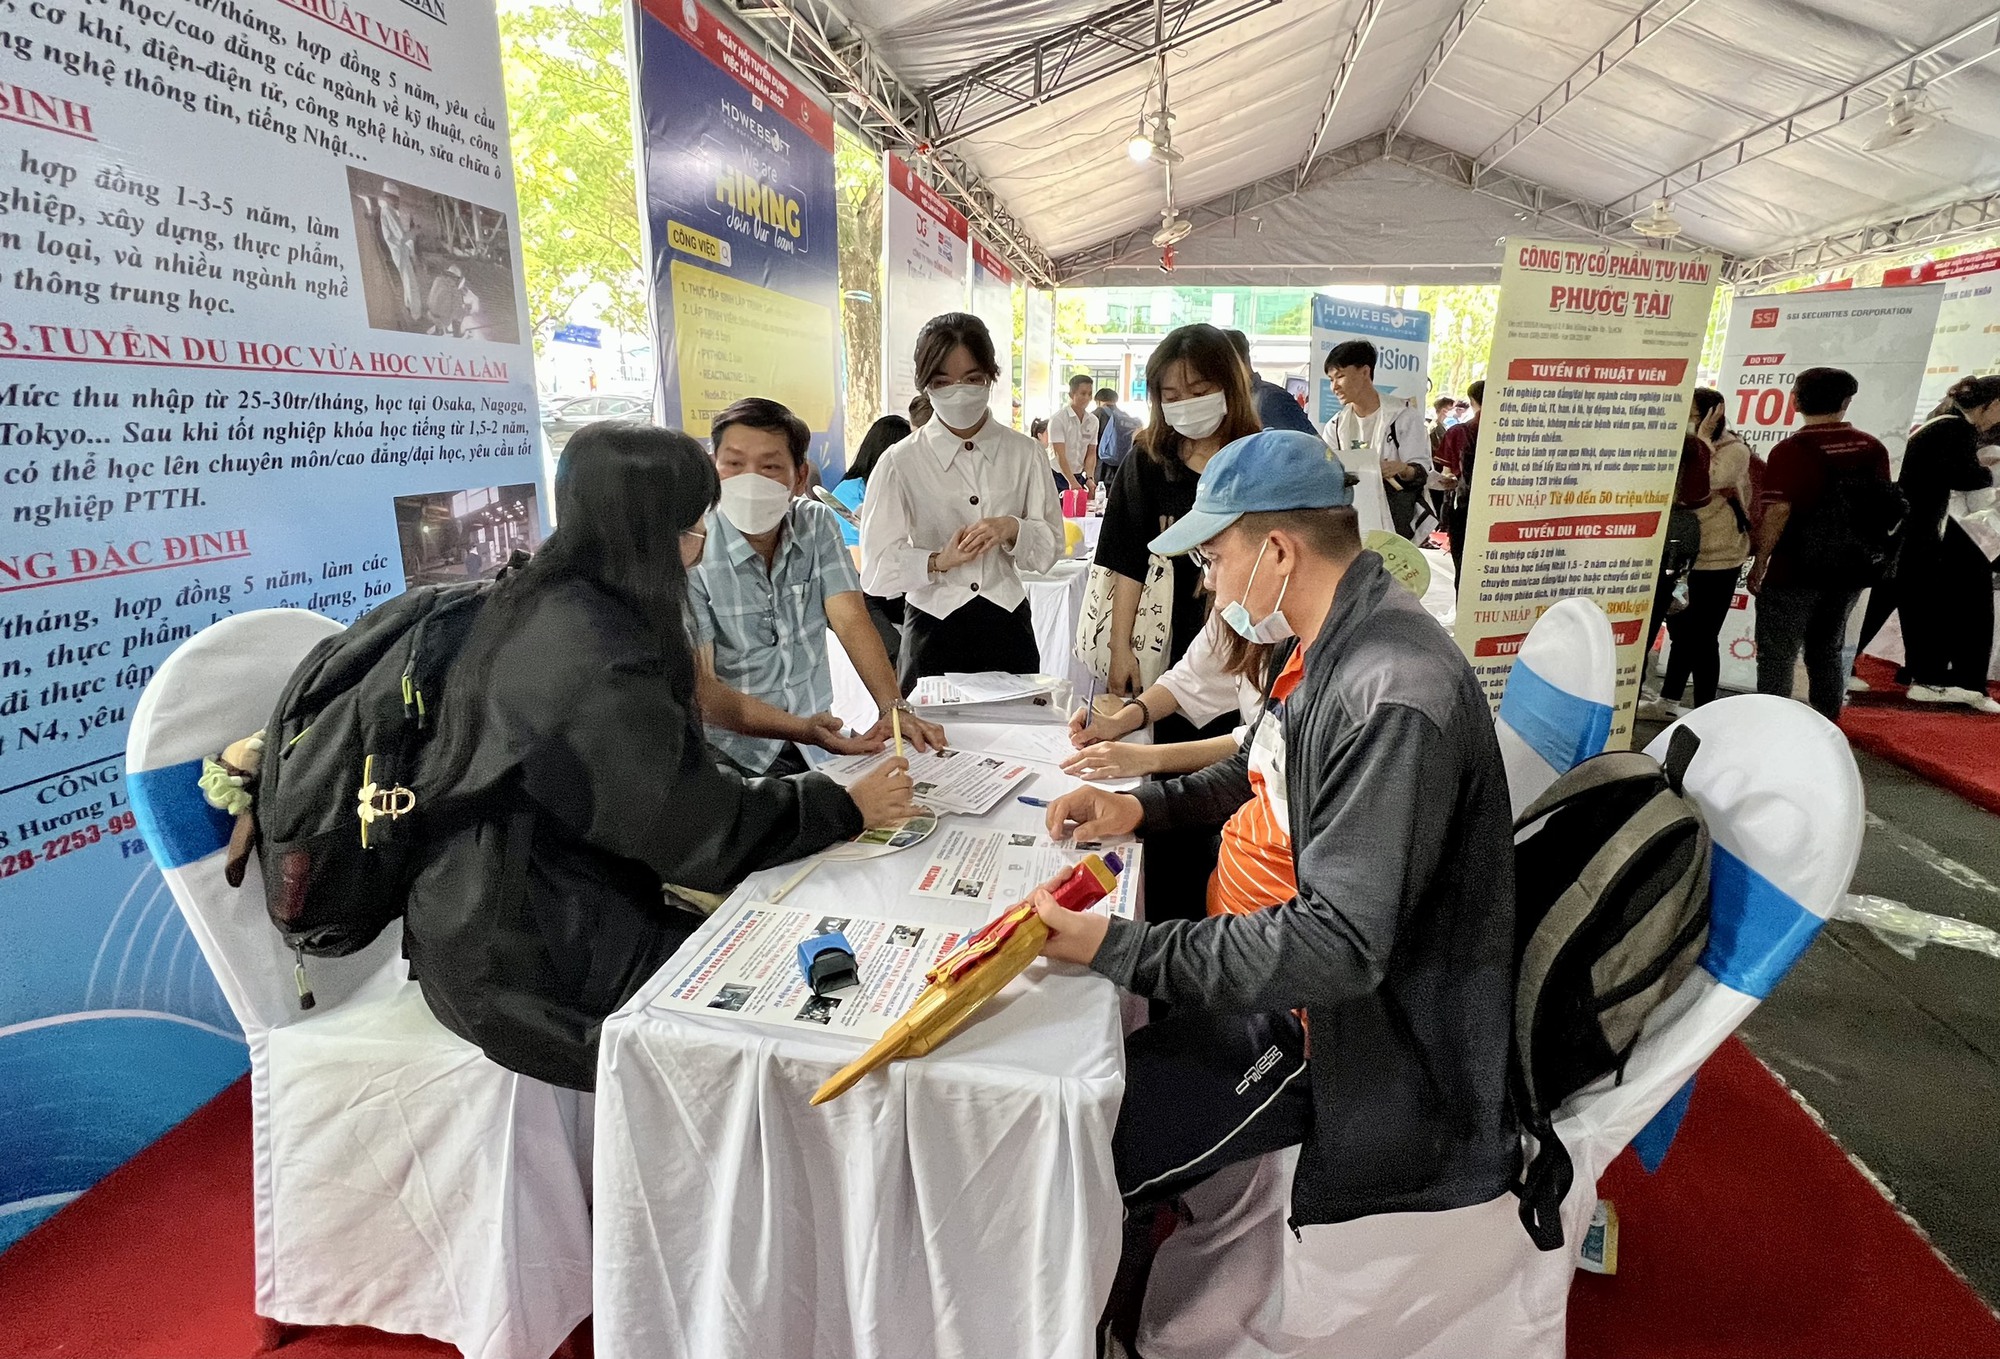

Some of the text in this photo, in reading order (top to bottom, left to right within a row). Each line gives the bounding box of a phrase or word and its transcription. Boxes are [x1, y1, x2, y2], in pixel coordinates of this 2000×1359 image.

[376, 22, 430, 65] VIÊN
[30, 1, 502, 180] cơ khí, điện-điện tử, công nghệ hàn, sửa chữa ô
[225, 33, 276, 75] đẳng
[284, 62, 316, 84] các
[323, 76, 376, 109] ngành
[383, 94, 399, 117] về
[405, 104, 422, 128] kỹ
[427, 116, 465, 145] thuật,
[469, 134, 499, 160] công
[297, 31, 496, 131] hợp đồng 5 năm, yêu cầu
[740, 145, 778, 183] We are
[715, 165, 801, 238] HIRING
[727, 204, 751, 235] Join
[754, 217, 770, 243] Our
[673, 229, 716, 258] CÔNG VIỆC
[1519, 245, 1709, 282] CÔNG TY CỔ PHẦN TƯ VẤN
[1550, 285, 1672, 317] PHƯỚC TÀI
[1754, 312, 1775, 324] SSI
[1801, 310, 1849, 319] SECURITIES
[1851, 307, 1913, 317] CORPORATION
[182, 336, 228, 363] DU
[237, 341, 303, 369] HỌC
[309, 343, 364, 371] VỪA
[370, 352, 418, 376] HỌC
[422, 355, 467, 378] VỪA
[469, 356, 508, 379] LÀM
[1377, 346, 1419, 372] ision
[1532, 361, 1666, 382] TUYỂN KỸ THUẬT VIÊN
[1750, 356, 1761, 364] DO
[1739, 373, 1774, 385] CARE
[0, 383, 527, 415] Mức thu nhập từ 25-30tr/tháng, học tại Osaka, Nagoga,
[0, 415, 529, 451] Tokyo... Sau khi tốt nghiệp khóa học tiếng từ 1,5-2 năm,
[4, 437, 532, 485] có thể học lên chuyên môn/cao đẳng/đại học, yêu cầu tốt
[13, 487, 207, 527] nghiệp PTTH.
[1488, 494, 1514, 507] THU
[1516, 491, 1547, 509] NHẬP
[1577, 489, 1596, 505] đến
[1599, 491, 1612, 504] 50
[1518, 523, 1636, 538] TUYỂN DU HỌC SINH
[66, 529, 249, 574] ĐẶC ĐỊNH
[1474, 610, 1500, 623] THU
[1502, 605, 1531, 624] NHẬP
[19, 719, 69, 750] N4,
[77, 705, 125, 739] yêu
[37, 765, 119, 805] CÔNG
[18, 801, 104, 842] Hương
